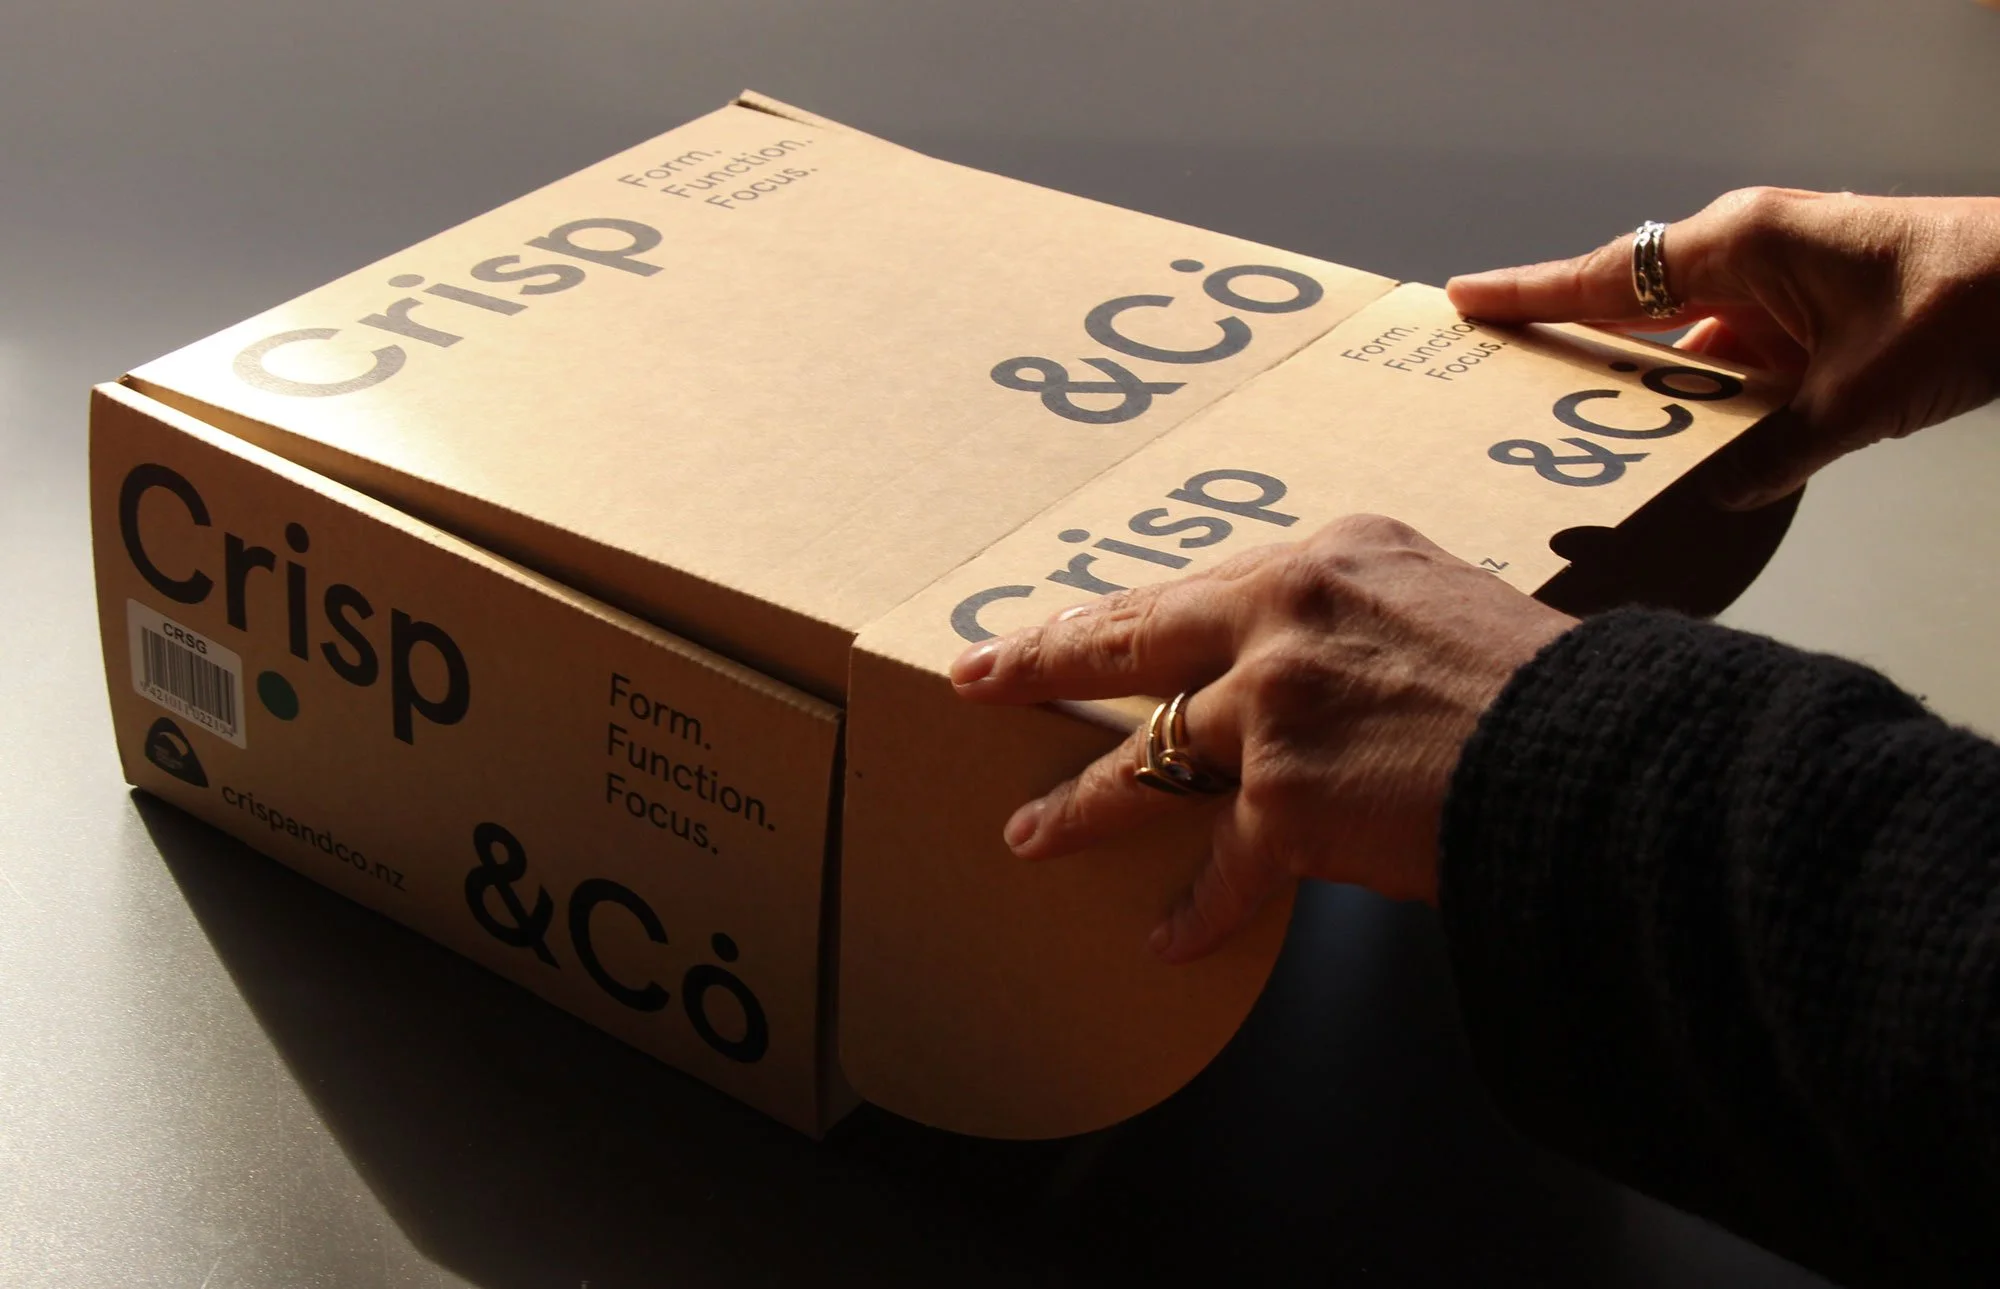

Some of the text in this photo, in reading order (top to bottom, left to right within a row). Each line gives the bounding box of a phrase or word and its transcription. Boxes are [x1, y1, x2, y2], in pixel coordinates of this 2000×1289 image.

[617, 148, 722, 188] Form.
[660, 138, 813, 198] Function.
[704, 167, 818, 209] Focus.
[232, 217, 665, 398] Crisp
[1340, 325, 1420, 362] Form.
[1383, 319, 1479, 372] Functio
[1425, 341, 1508, 381] Focus.
[118, 463, 471, 745] Crisp
[162, 621, 208, 656] CRSG
[610, 672, 712, 751] Form.
[606, 722, 775, 831] Function.
[221, 784, 406, 893] crispandco.nz
[605, 772, 719, 855] Focus.
